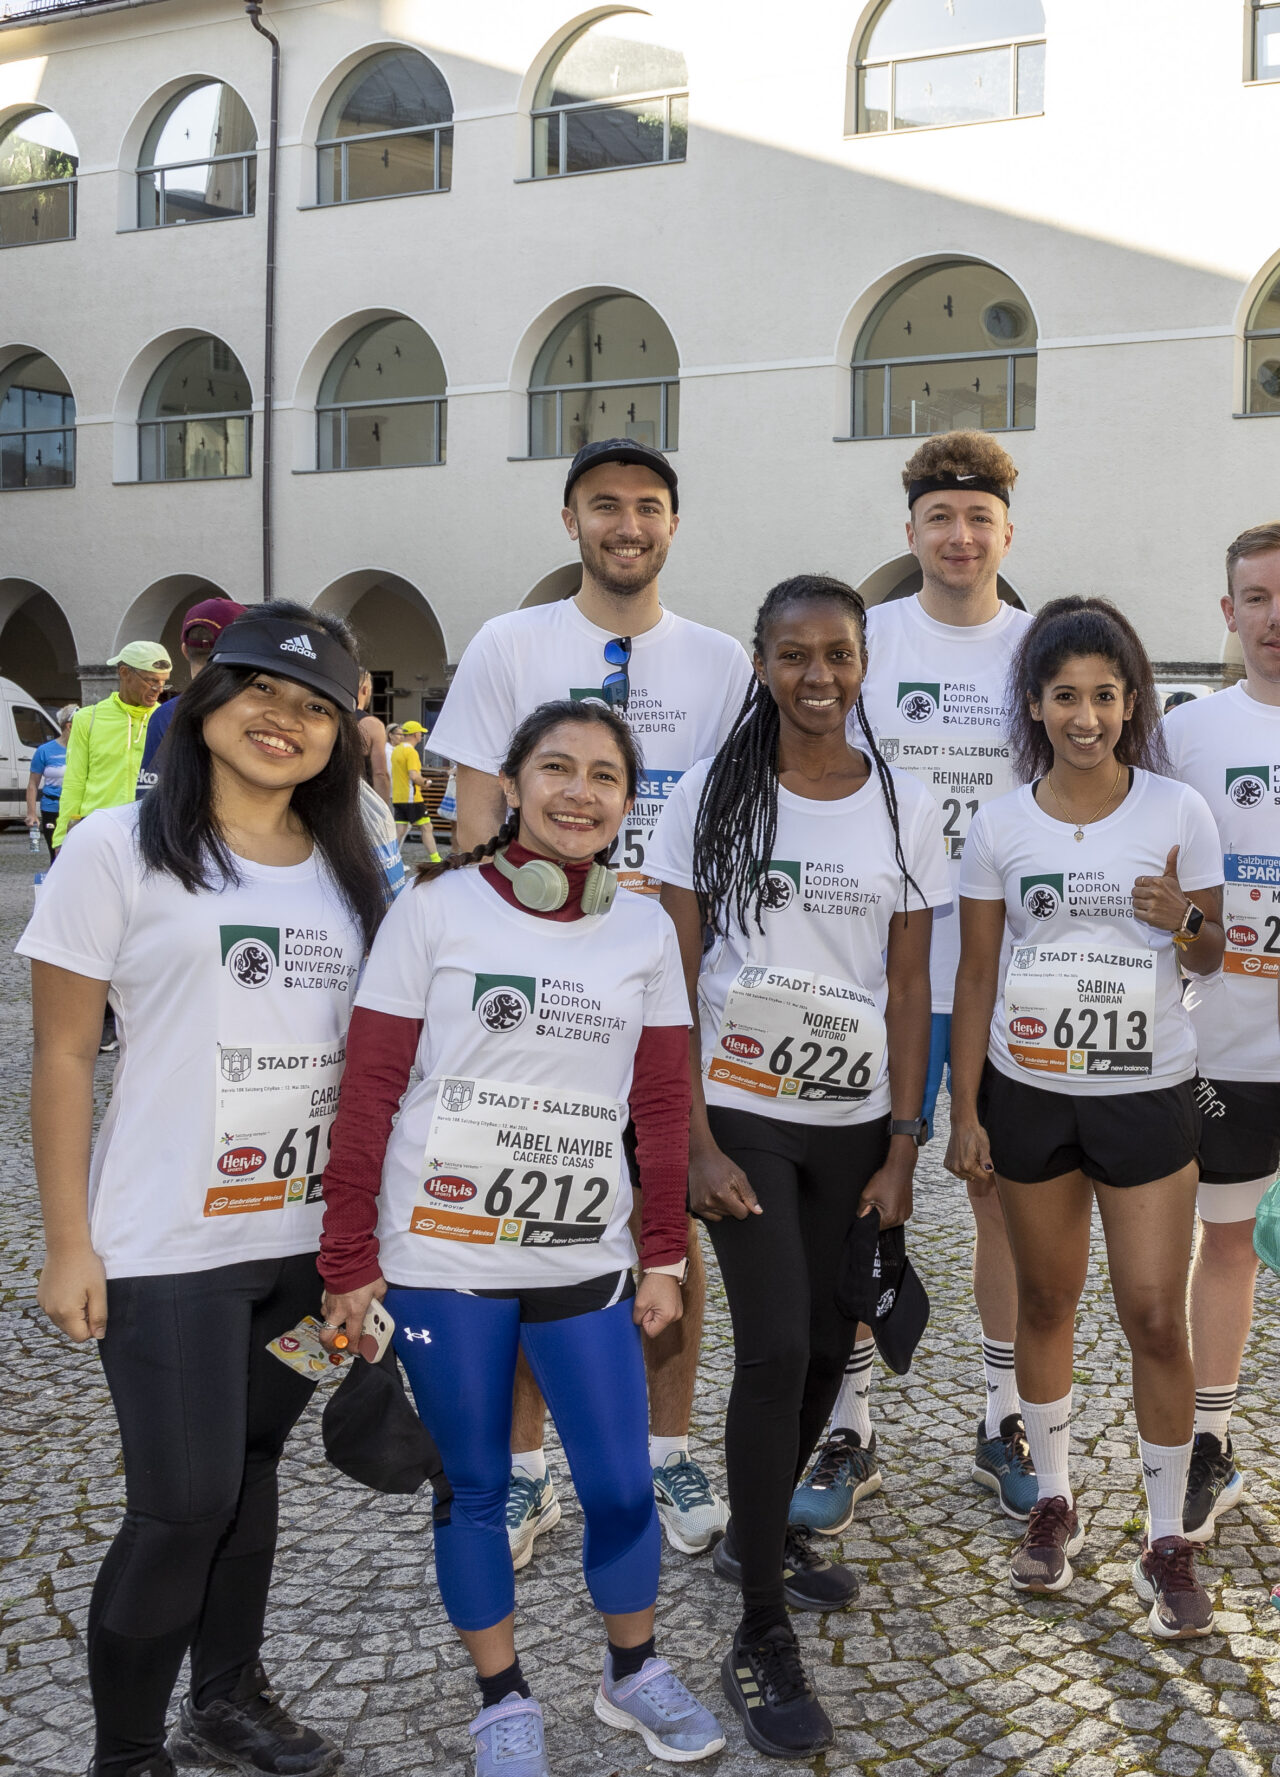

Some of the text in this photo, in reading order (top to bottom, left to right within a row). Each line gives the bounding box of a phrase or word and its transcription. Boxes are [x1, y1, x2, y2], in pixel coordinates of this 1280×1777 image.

[280, 644, 316, 660] adidas
[616, 689, 648, 698] PRIS
[944, 684, 976, 692] PARIS
[944, 694, 988, 704] LODRON
[630, 723, 676, 733] LZBURG
[942, 716, 1000, 726] SALZBURG
[903, 746, 1009, 758] STADT SALZBURG
[138, 768, 158, 784] ko
[933, 772, 993, 785] REINHARD
[609, 830, 652, 869] 25
[806, 862, 844, 873] PARIS
[806, 876, 859, 888] LODRON
[1068, 872, 1104, 880] PARIS
[1068, 884, 1120, 893] LODRON
[804, 890, 881, 904] UNIVERSITÄT
[803, 903, 866, 916] SALZBURG
[1070, 908, 1133, 918] SALZBURG
[285, 928, 328, 940] PARIS
[1230, 929, 1256, 942] Hervis
[285, 944, 343, 958] LODRON
[1040, 952, 1153, 969] STADT SALZBURG
[284, 960, 358, 978] UNIVERSIT
[284, 977, 348, 992] SALZBURG
[542, 978, 584, 992] PARIS
[767, 974, 876, 1008] STADT SALZBURG
[1077, 980, 1126, 994] SABINA
[541, 994, 600, 1010] LODRON
[1079, 994, 1122, 1004] CHANDRAN
[540, 1009, 627, 1030] UNIVERSITÄT
[803, 1012, 859, 1034] NOREEN
[1012, 1020, 1044, 1034] Hervis
[1054, 1008, 1148, 1050] 6213
[536, 1025, 610, 1044] SALZBURG
[810, 1028, 846, 1042] MUTORO
[724, 1037, 761, 1056] Hervis
[257, 1056, 310, 1070] STADT
[769, 1036, 874, 1088] 6226
[478, 1092, 617, 1122] STADT SALZBURG
[496, 1130, 614, 1158] MABEL NAYIBE
[222, 1154, 263, 1169] Hervis
[513, 1150, 594, 1169] CACERES CASAS
[430, 1180, 472, 1198] Hervis
[484, 1168, 610, 1223] 6212
[436, 1224, 471, 1234] Gebrüder
